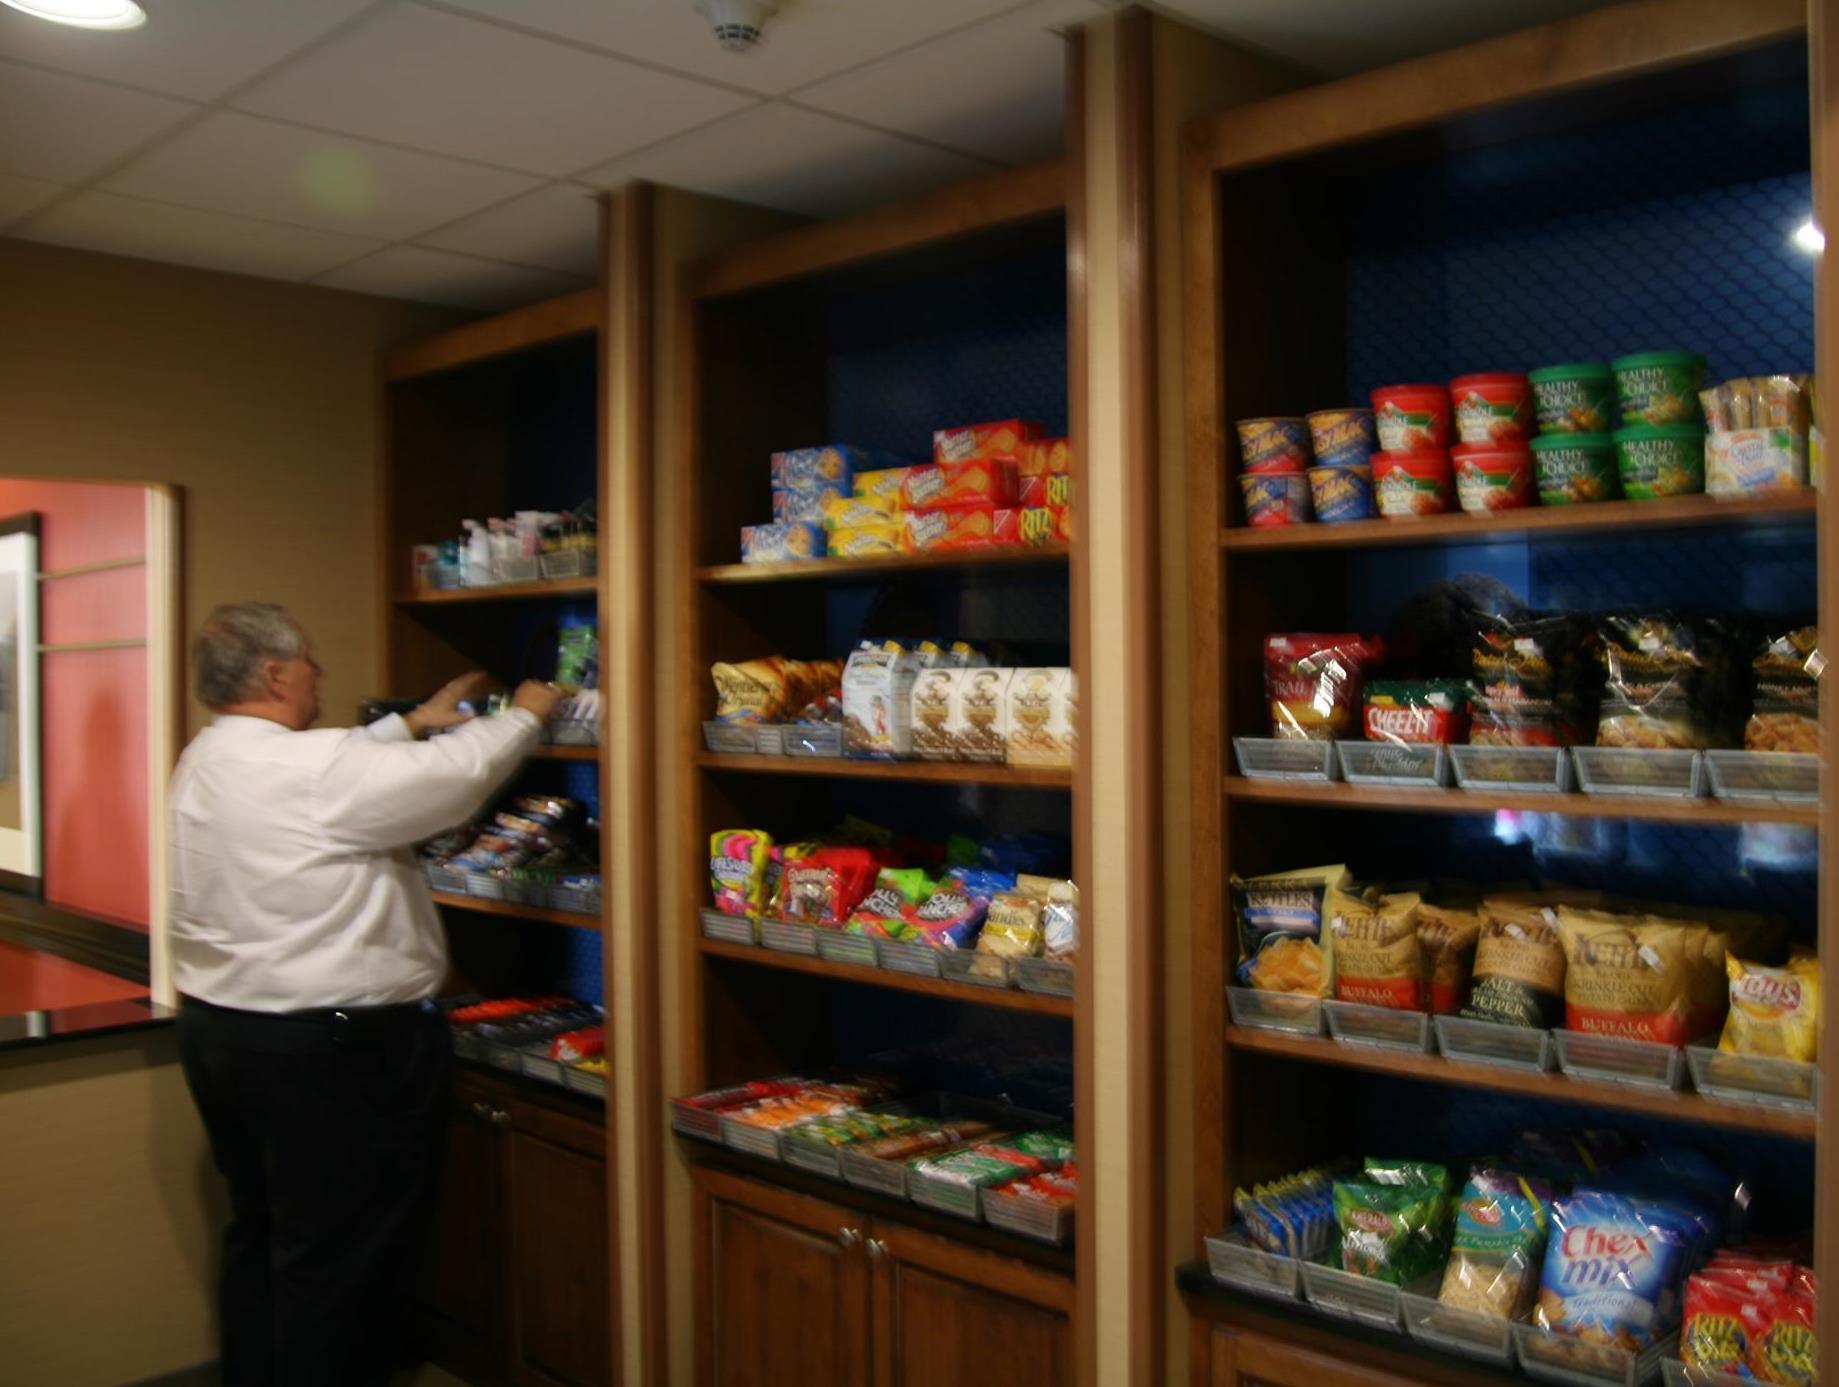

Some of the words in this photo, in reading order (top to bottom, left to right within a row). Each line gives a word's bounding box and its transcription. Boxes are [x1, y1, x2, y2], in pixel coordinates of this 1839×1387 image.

[1046, 474, 1071, 505] RIT
[1470, 993, 1526, 1017] PEPPER
[1581, 1016, 1650, 1034] BUFFALO
[1561, 1222, 1655, 1264] Chex
[1561, 1254, 1641, 1287] mix
